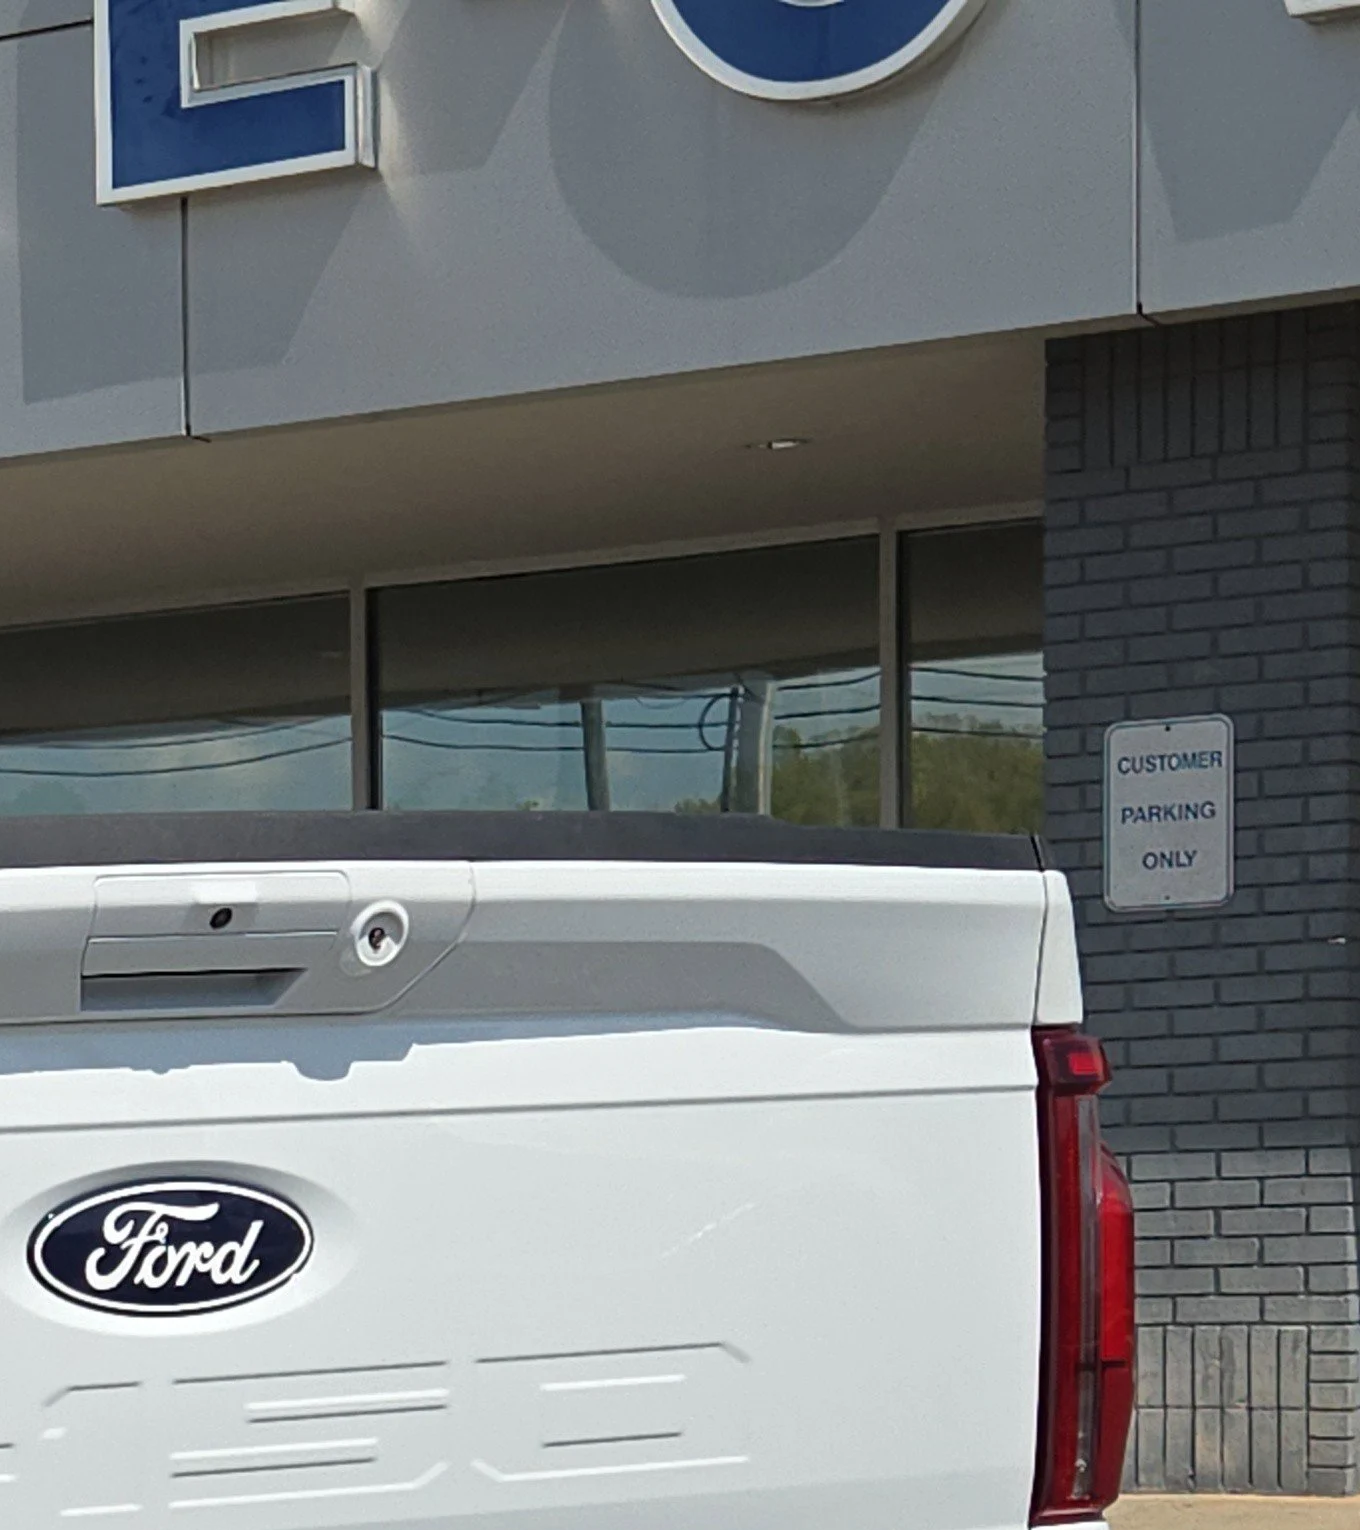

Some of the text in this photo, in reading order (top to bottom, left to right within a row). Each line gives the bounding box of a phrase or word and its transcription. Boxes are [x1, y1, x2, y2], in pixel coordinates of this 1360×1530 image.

[1118, 751, 1223, 775] CUSTOMER
[1121, 801, 1216, 824] PARKING
[1142, 851, 1197, 870] ONLY
[85, 1202, 264, 1291] Ford
